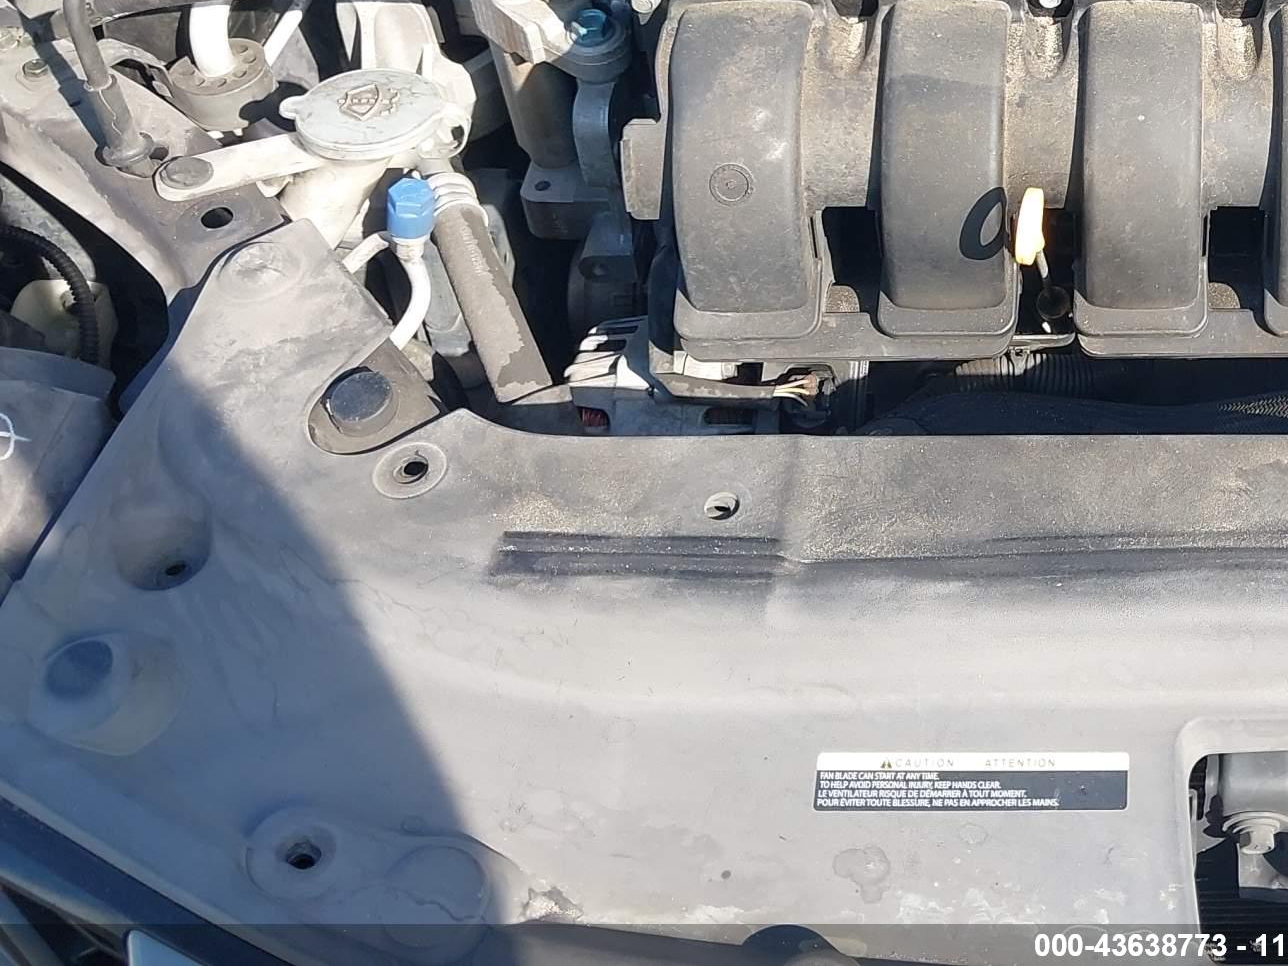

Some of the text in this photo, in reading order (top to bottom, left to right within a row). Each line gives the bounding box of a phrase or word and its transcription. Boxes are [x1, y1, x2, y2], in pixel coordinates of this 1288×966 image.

[896, 758, 1056, 768] CAUTION ATTENTION
[820, 772, 940, 780] FAN BLADE CAN START AT ANY TIME.
[820, 781, 1001, 789] TO HELP AVOID PERSONAL INJURY, KEEP HANDS CLEAR.
[818, 789, 1027, 798] LE VENTILATEUR RISQUE DE DÉMARRER À TOUT MOMENT.
[840, 798, 865, 806] ÉVITER
[892, 799, 930, 807] BLESSURE,
